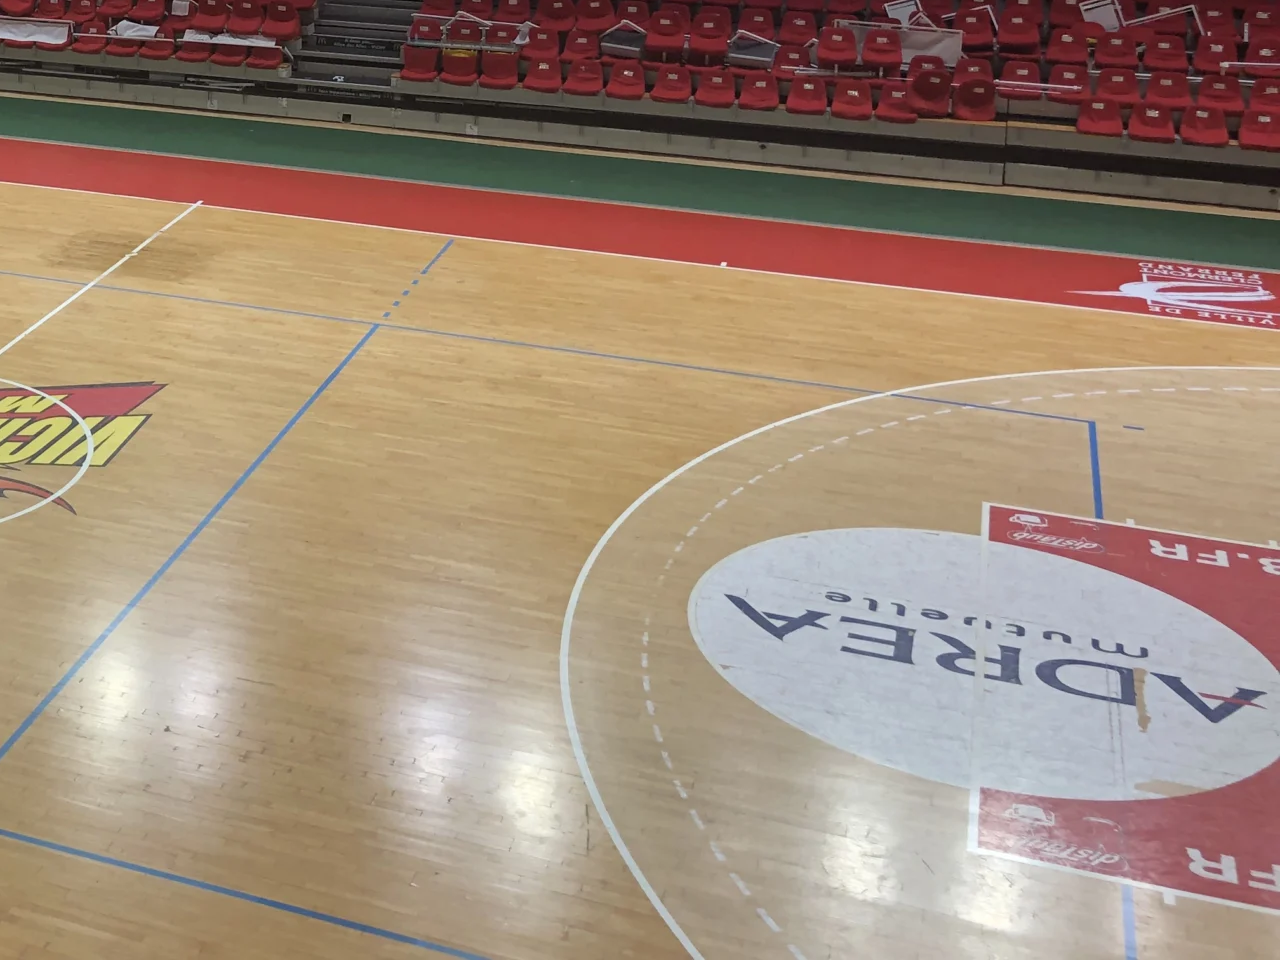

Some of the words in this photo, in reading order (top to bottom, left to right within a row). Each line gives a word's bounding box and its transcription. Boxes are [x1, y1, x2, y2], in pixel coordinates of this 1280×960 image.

[1138, 262, 1261, 279] FERRAND
[1140, 268, 1263, 285] CLERMONT
[1148, 305, 1182, 315] DE
[1197, 310, 1276, 326] VILLE
[824, 590, 1149, 660] mutuelle
[723, 593, 1269, 724] ADREA
